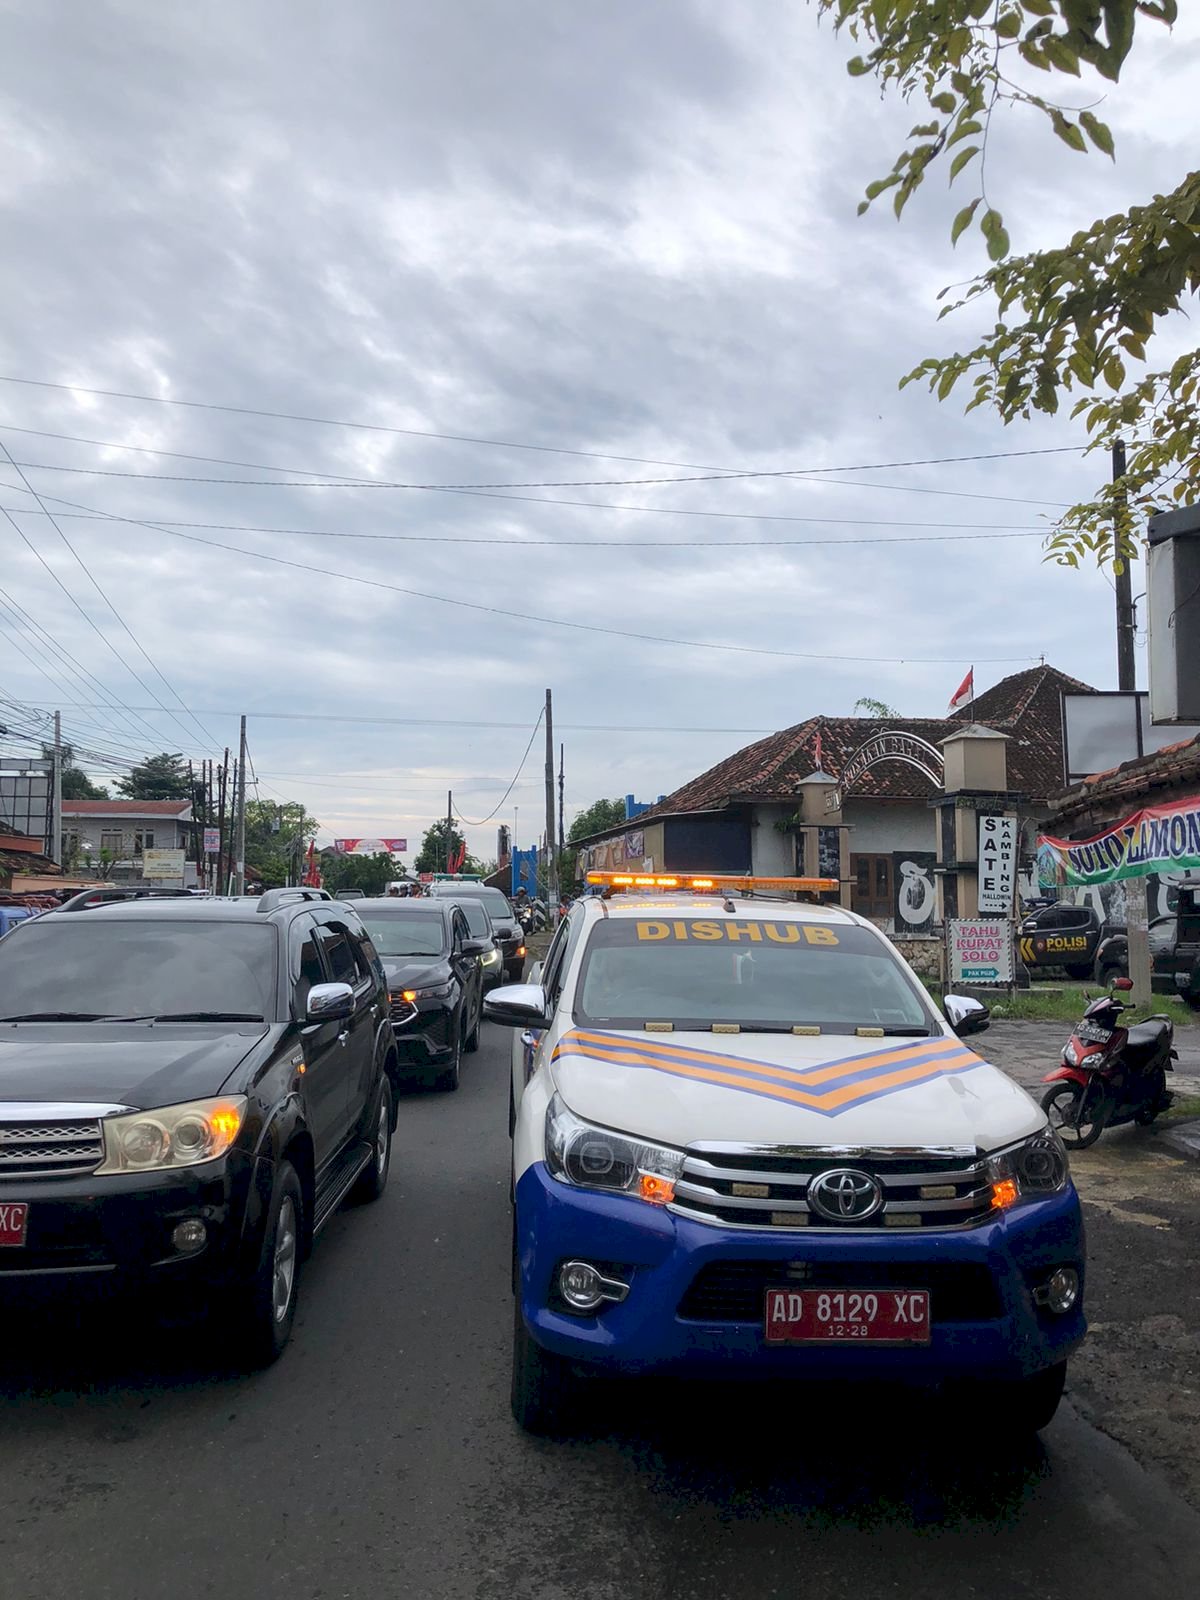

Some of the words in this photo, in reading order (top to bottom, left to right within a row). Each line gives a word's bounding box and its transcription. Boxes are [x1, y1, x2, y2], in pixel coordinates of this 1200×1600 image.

[983, 818, 998, 891] SATE
[1000, 820, 1012, 893] KAMBING
[636, 921, 840, 946] DISHUB
[956, 938, 1004, 950] KUPAT
[960, 926, 1000, 938] TAHU
[1046, 936, 1087, 948] POLISI
[961, 950, 1000, 963] SOLO
[0, 1206, 23, 1231] XC
[772, 1294, 803, 1322] AD
[816, 1294, 879, 1322] 8129
[894, 1294, 925, 1322] XC
